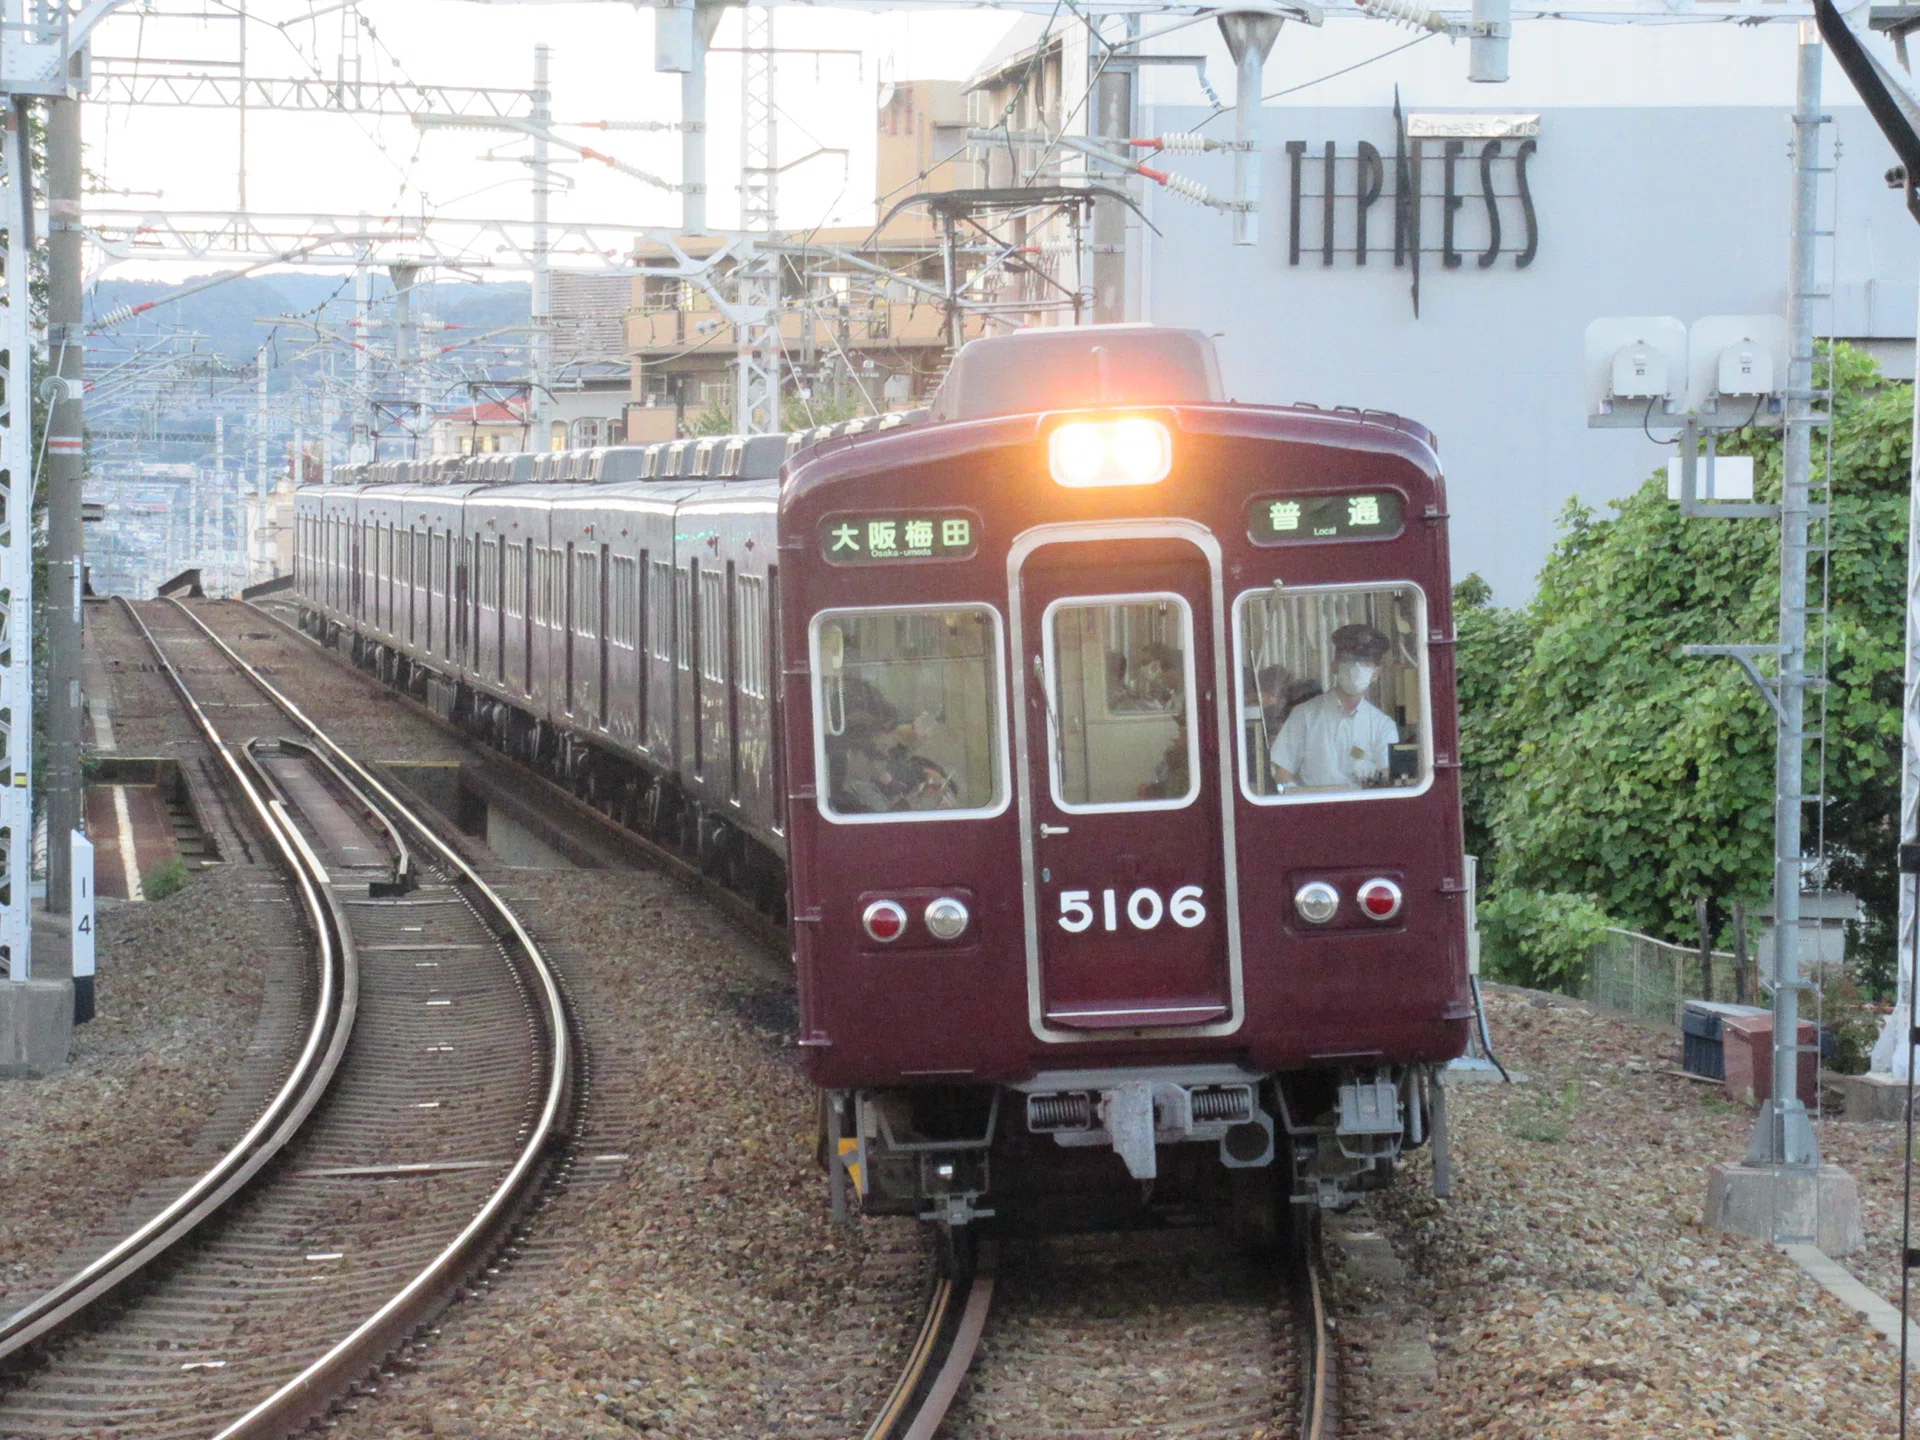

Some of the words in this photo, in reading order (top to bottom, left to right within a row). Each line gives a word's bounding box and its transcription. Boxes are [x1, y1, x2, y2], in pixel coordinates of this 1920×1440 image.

[1286, 82, 1538, 320] TIPNESS
[1269, 497, 1381, 531] 普通
[831, 519, 970, 551] 大阪梅田
[1313, 527, 1337, 536] Local
[1058, 886, 1206, 933] 5106
